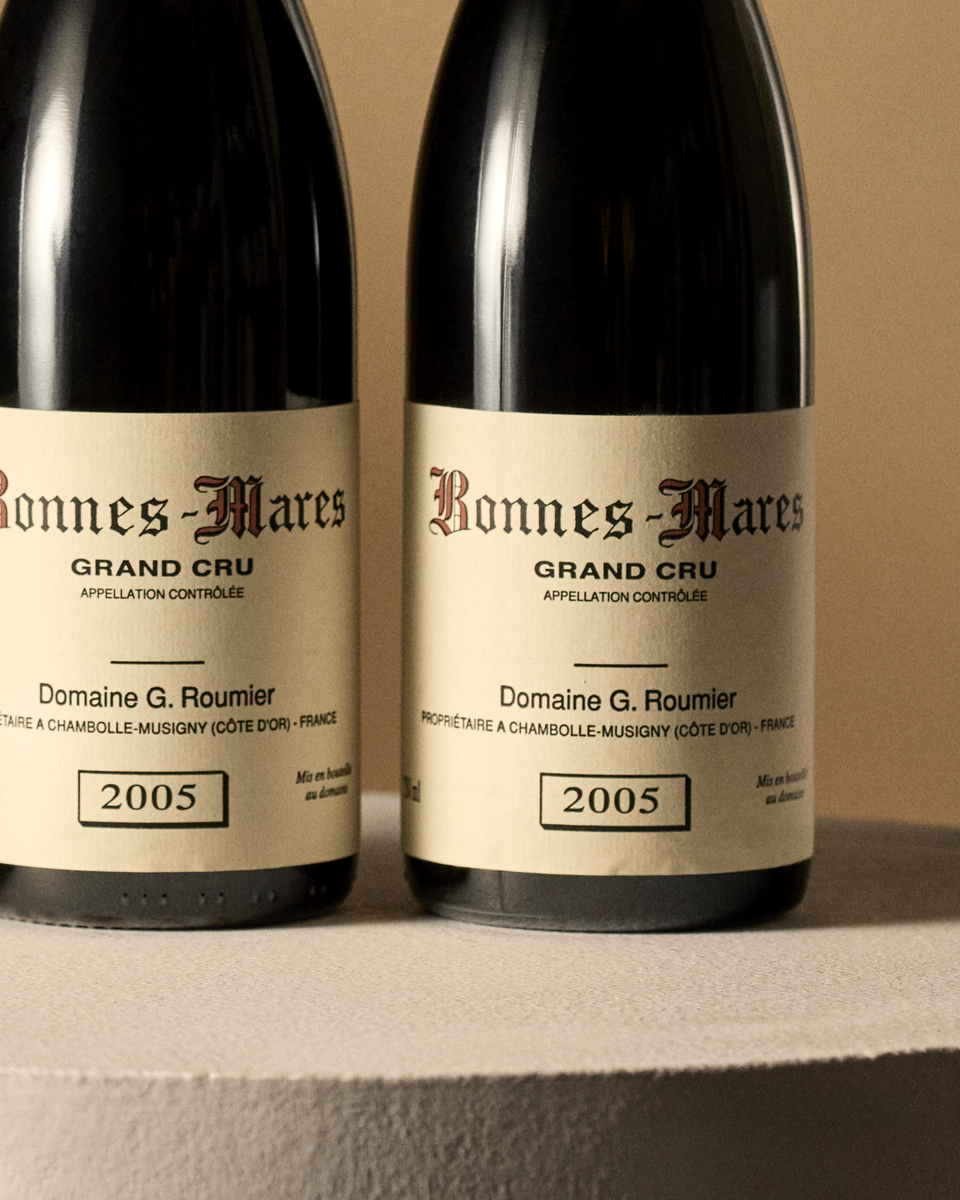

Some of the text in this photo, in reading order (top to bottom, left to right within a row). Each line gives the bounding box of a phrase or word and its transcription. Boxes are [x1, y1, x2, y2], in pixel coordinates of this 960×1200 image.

[70, 556, 255, 578] GRAND CRU
[533, 559, 718, 581] GRAND CRU
[80, 584, 245, 601] APPELLATION CONTRÔLÉE
[543, 588, 708, 604] APPELLATION CONTRÔLÉE
[38, 682, 277, 710] Domaine G. Roumier
[499, 684, 738, 713] Domaine G. Roumier
[47, 718, 208, 736] CHAMBOLLE-MUSIGNY
[210, 717, 255, 737] (CÔTE
[256, 716, 291, 733] D'OR)
[299, 710, 337, 729] FRANCE
[421, 710, 494, 733] PROPRIÉTAIRE
[508, 720, 671, 739] CHAMBOLLE-MUSIGNY
[673, 720, 717, 741] (CÔTE
[718, 720, 753, 737] D'OR)
[759, 715, 795, 733] FRANCE
[295, 770, 314, 785] Mis
[314, 771, 326, 782] en
[756, 774, 774, 789] Mis
[774, 775, 785, 786] en
[100, 783, 197, 811] 2005
[305, 789, 318, 801] au
[562, 785, 660, 815] 2005
[765, 793, 778, 806] au
